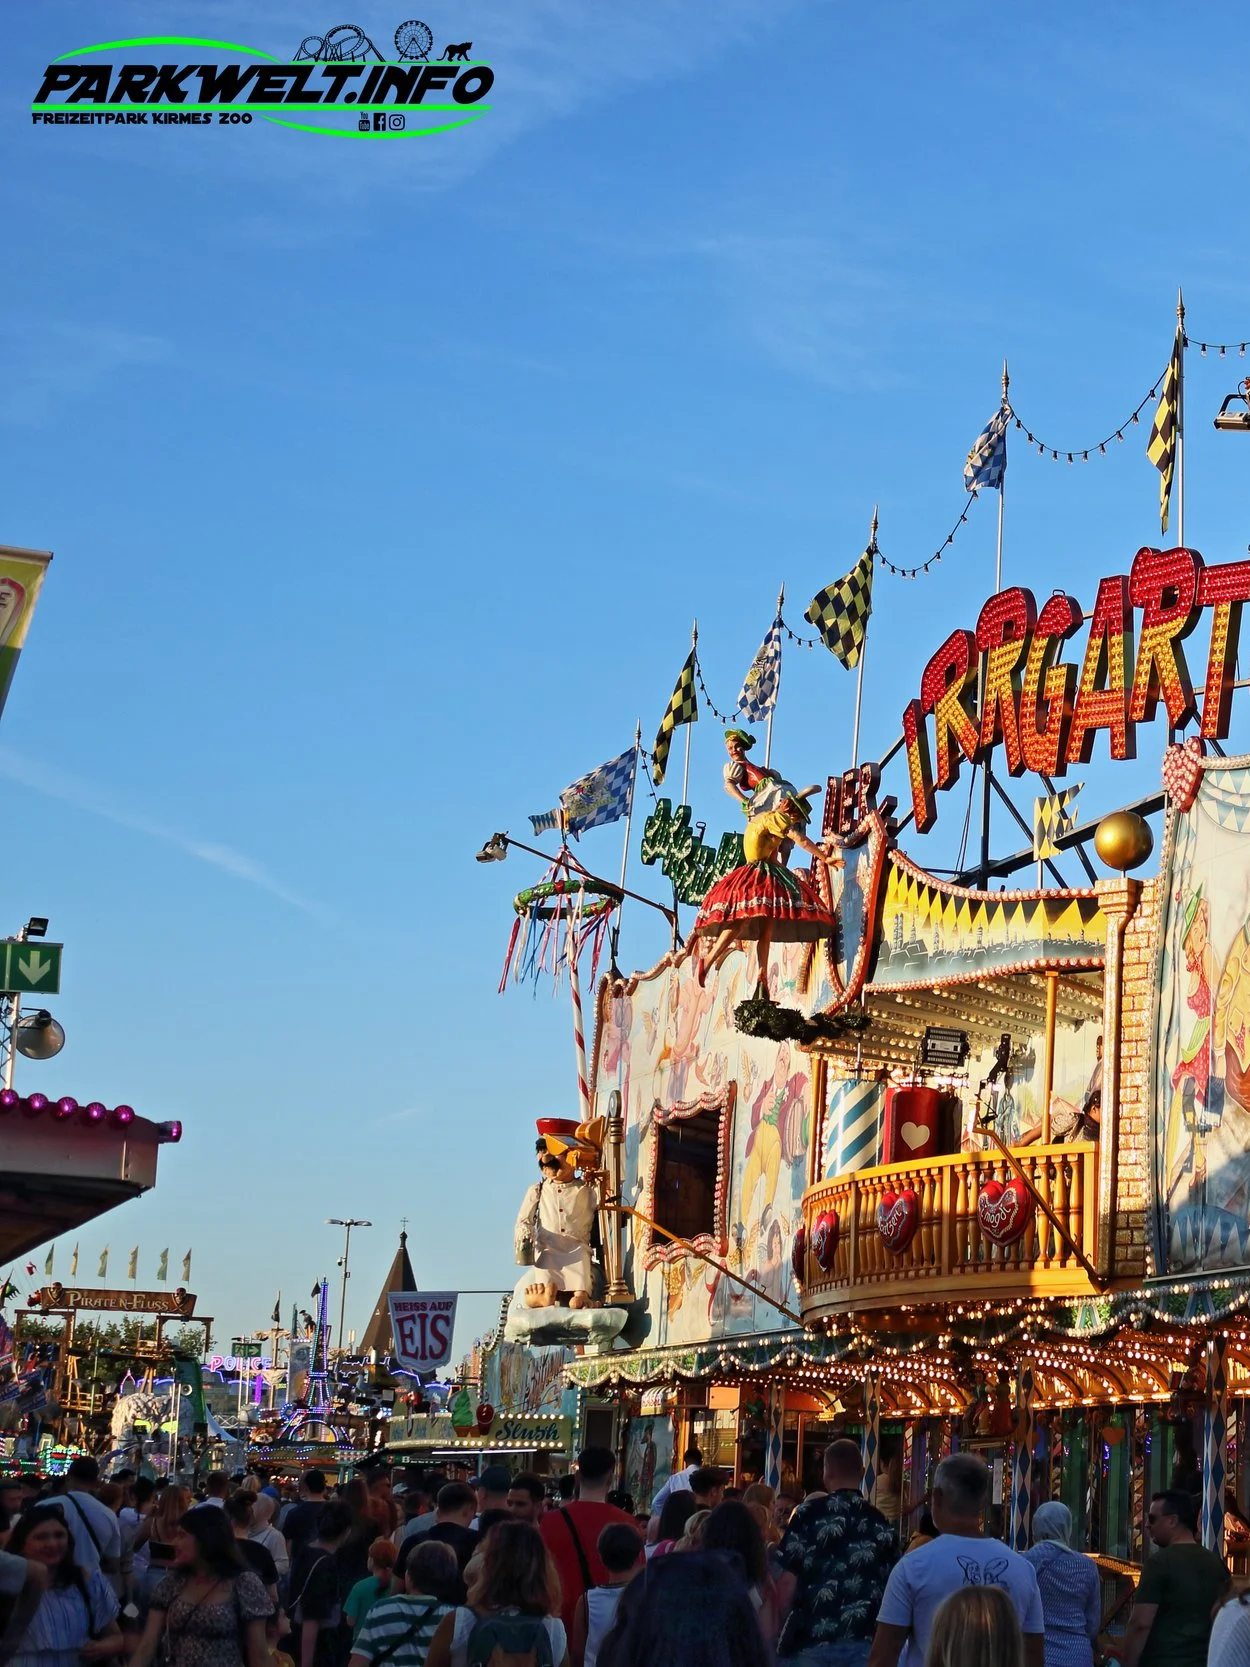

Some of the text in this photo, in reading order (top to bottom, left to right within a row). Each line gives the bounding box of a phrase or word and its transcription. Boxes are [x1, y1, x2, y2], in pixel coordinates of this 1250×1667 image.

[65, 1290, 170, 1311] PIRATEN-FLUSS
[394, 1301, 454, 1313] HEISS AUF
[395, 1313, 451, 1362] EIS
[209, 1355, 273, 1373] POLICE
[495, 1418, 561, 1442] Slush
